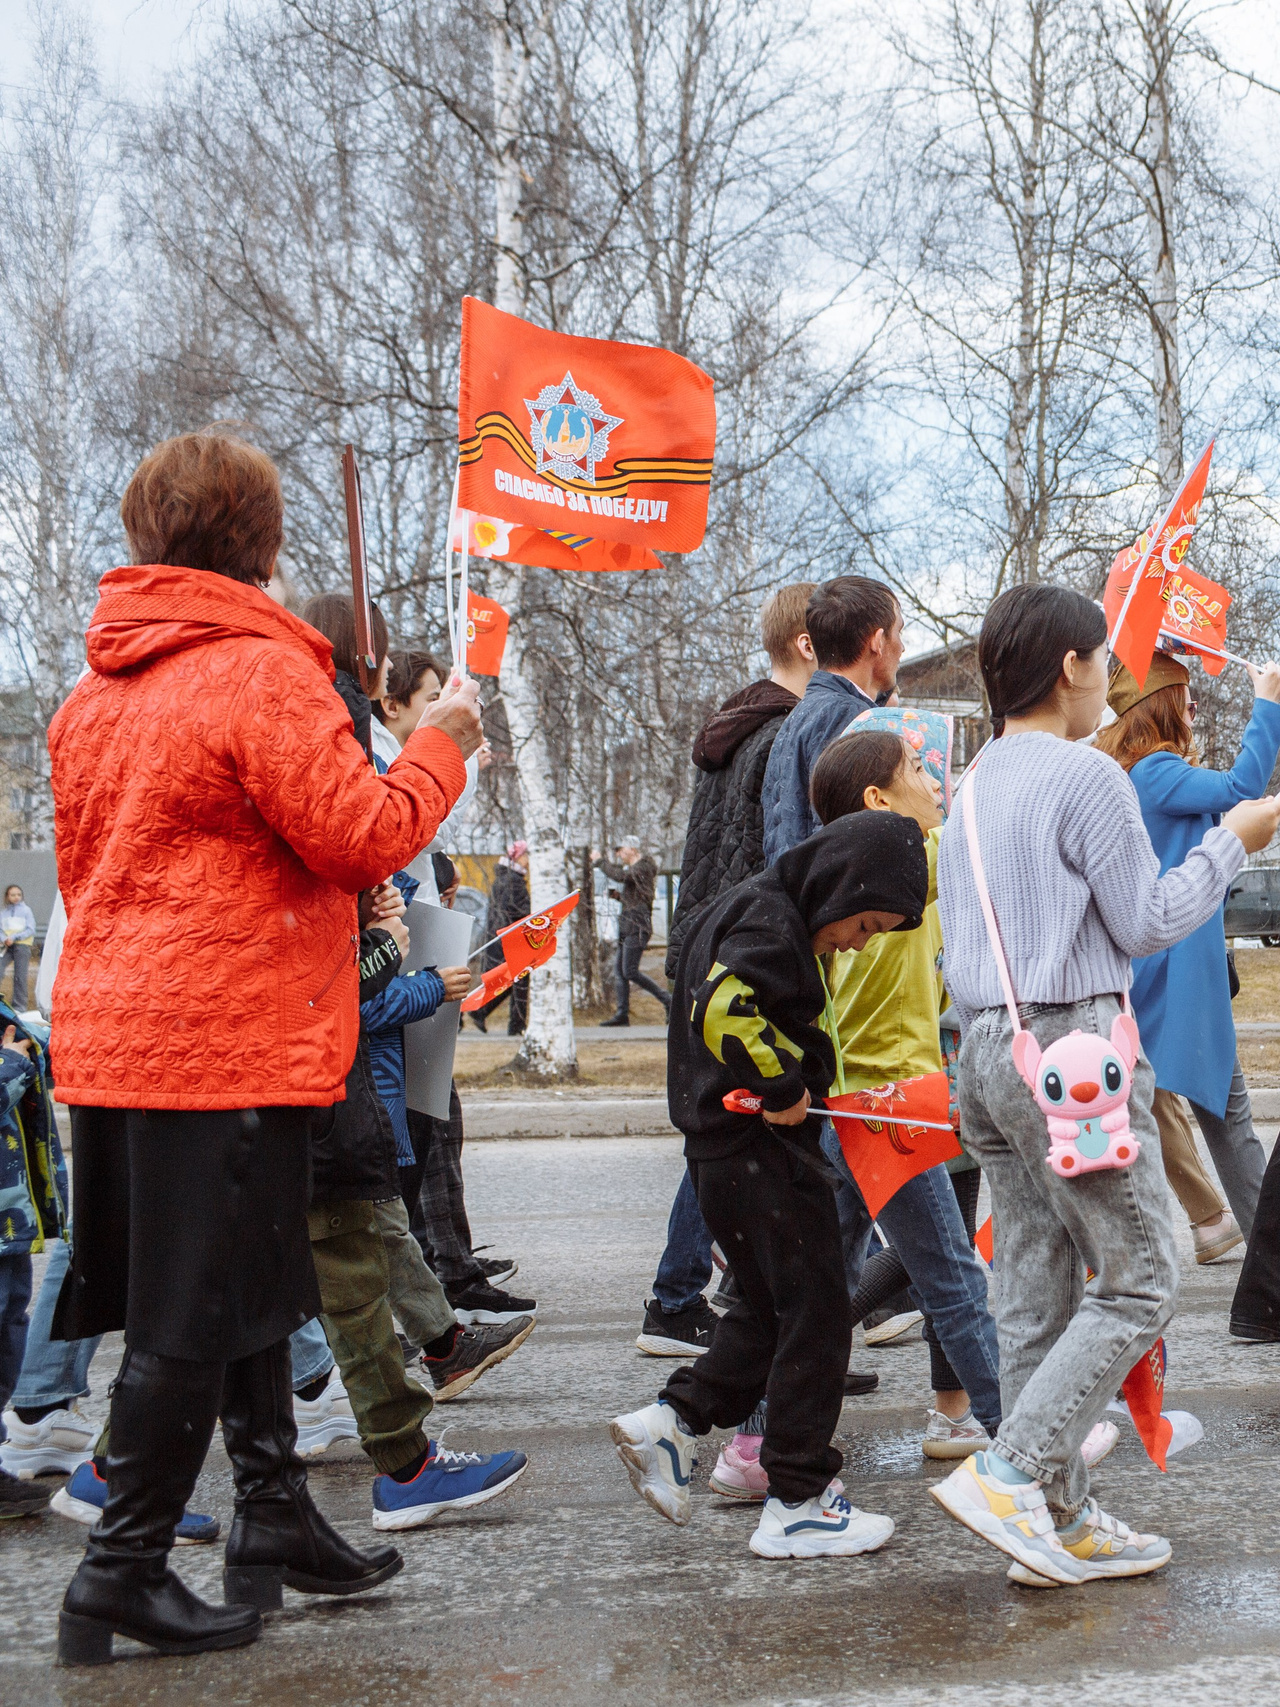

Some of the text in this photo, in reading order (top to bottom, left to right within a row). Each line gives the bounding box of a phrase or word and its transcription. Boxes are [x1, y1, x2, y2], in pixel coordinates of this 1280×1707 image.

[494, 468, 669, 524] СПАСИБО ЗА ПОБЕДУ!
